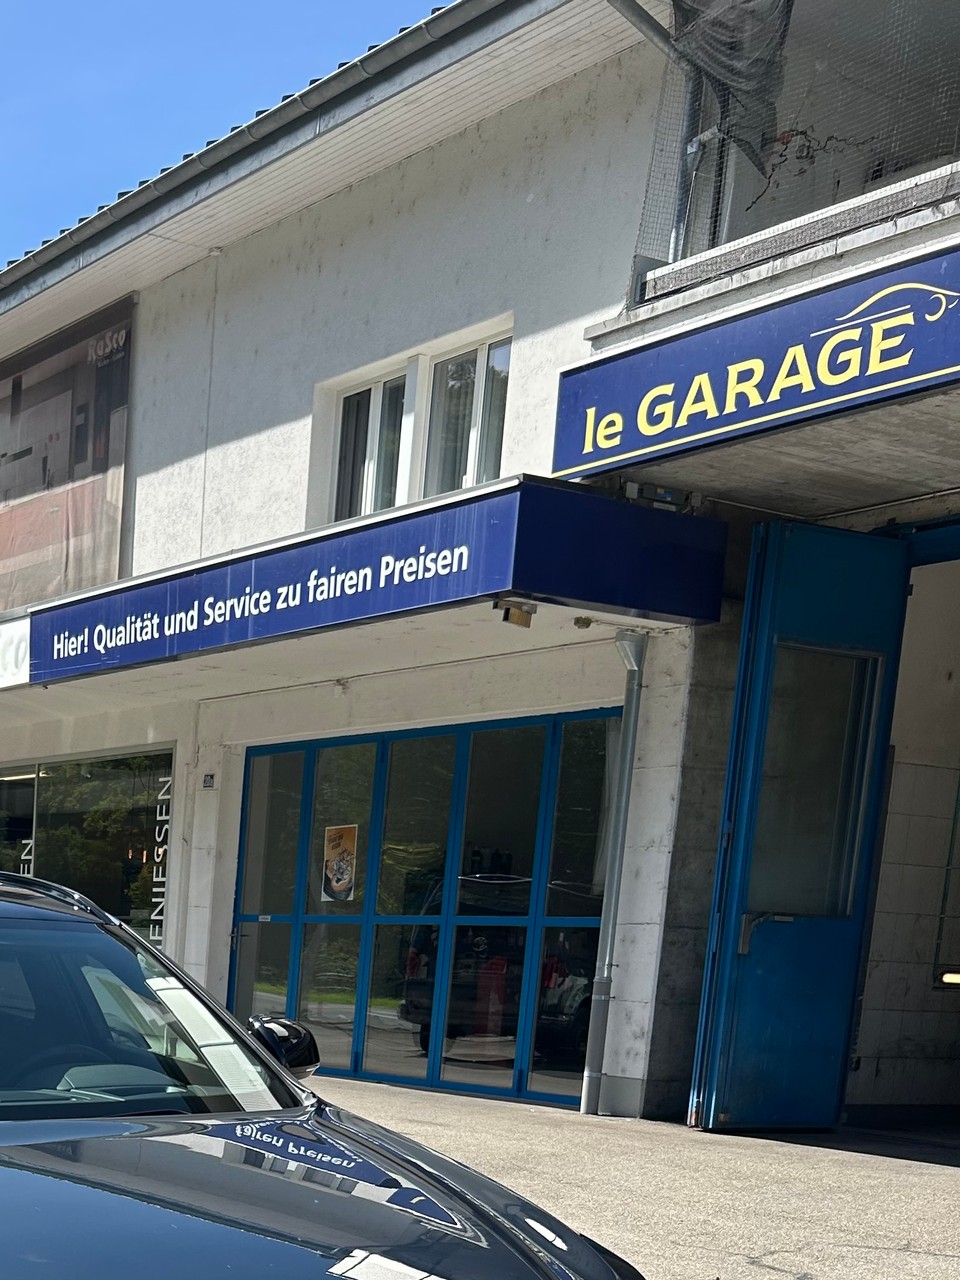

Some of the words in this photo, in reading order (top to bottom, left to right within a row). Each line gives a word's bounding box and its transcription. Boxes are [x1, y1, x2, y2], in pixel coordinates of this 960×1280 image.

[582, 407, 624, 454] le
[636, 312, 915, 436] GARAGE
[53, 627, 89, 660] Hier!
[93, 612, 160, 654] Qualität
[164, 600, 199, 637] und
[203, 586, 272, 626] Service
[276, 582, 302, 610] zu
[306, 565, 372, 603] fairen
[379, 544, 469, 588] Preisen
